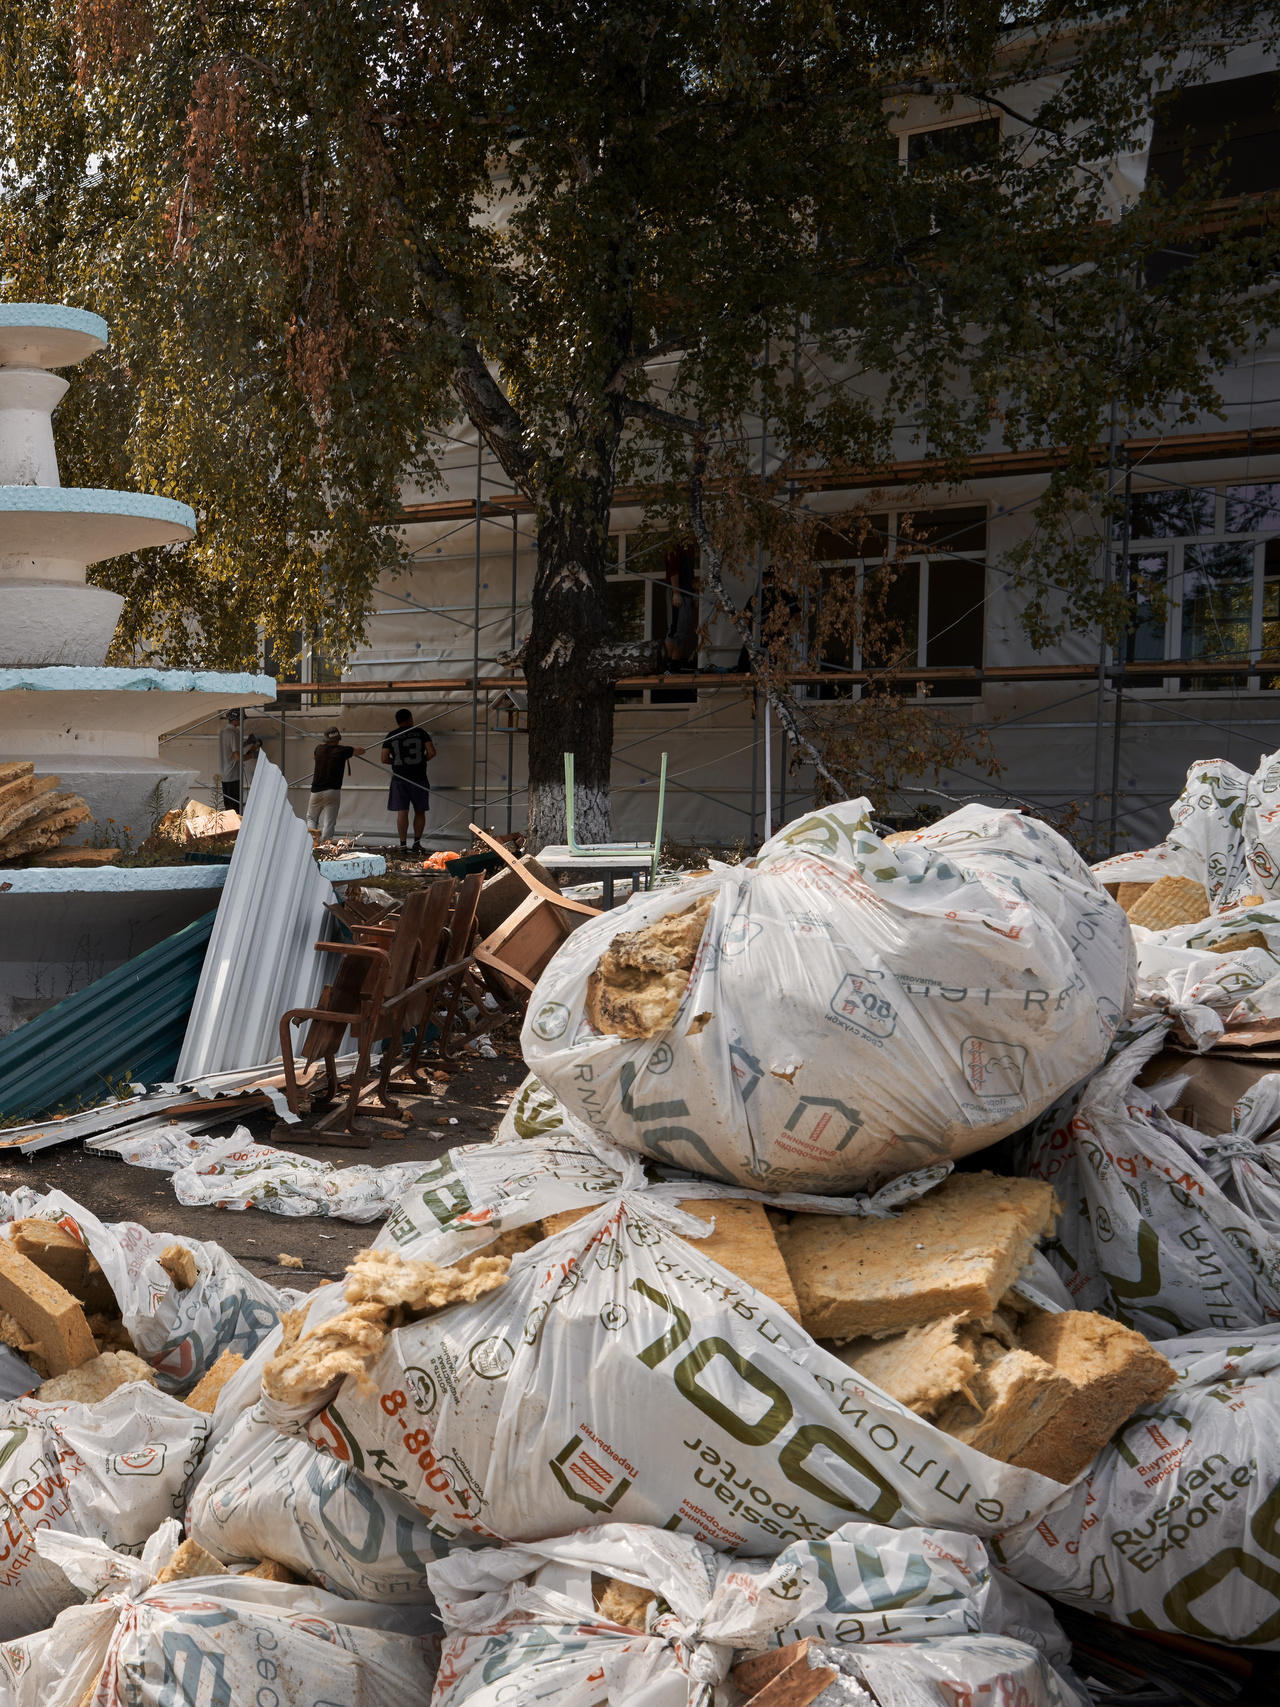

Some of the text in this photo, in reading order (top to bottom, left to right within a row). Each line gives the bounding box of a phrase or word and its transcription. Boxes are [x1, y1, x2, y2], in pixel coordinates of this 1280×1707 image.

[391, 737, 423, 766] 13
[579, 1422, 640, 1479] Перекрытия
[678, 1506, 740, 1548] Внутренние
[682, 1497, 750, 1544] перегородки
[692, 1466, 802, 1542] ussian
